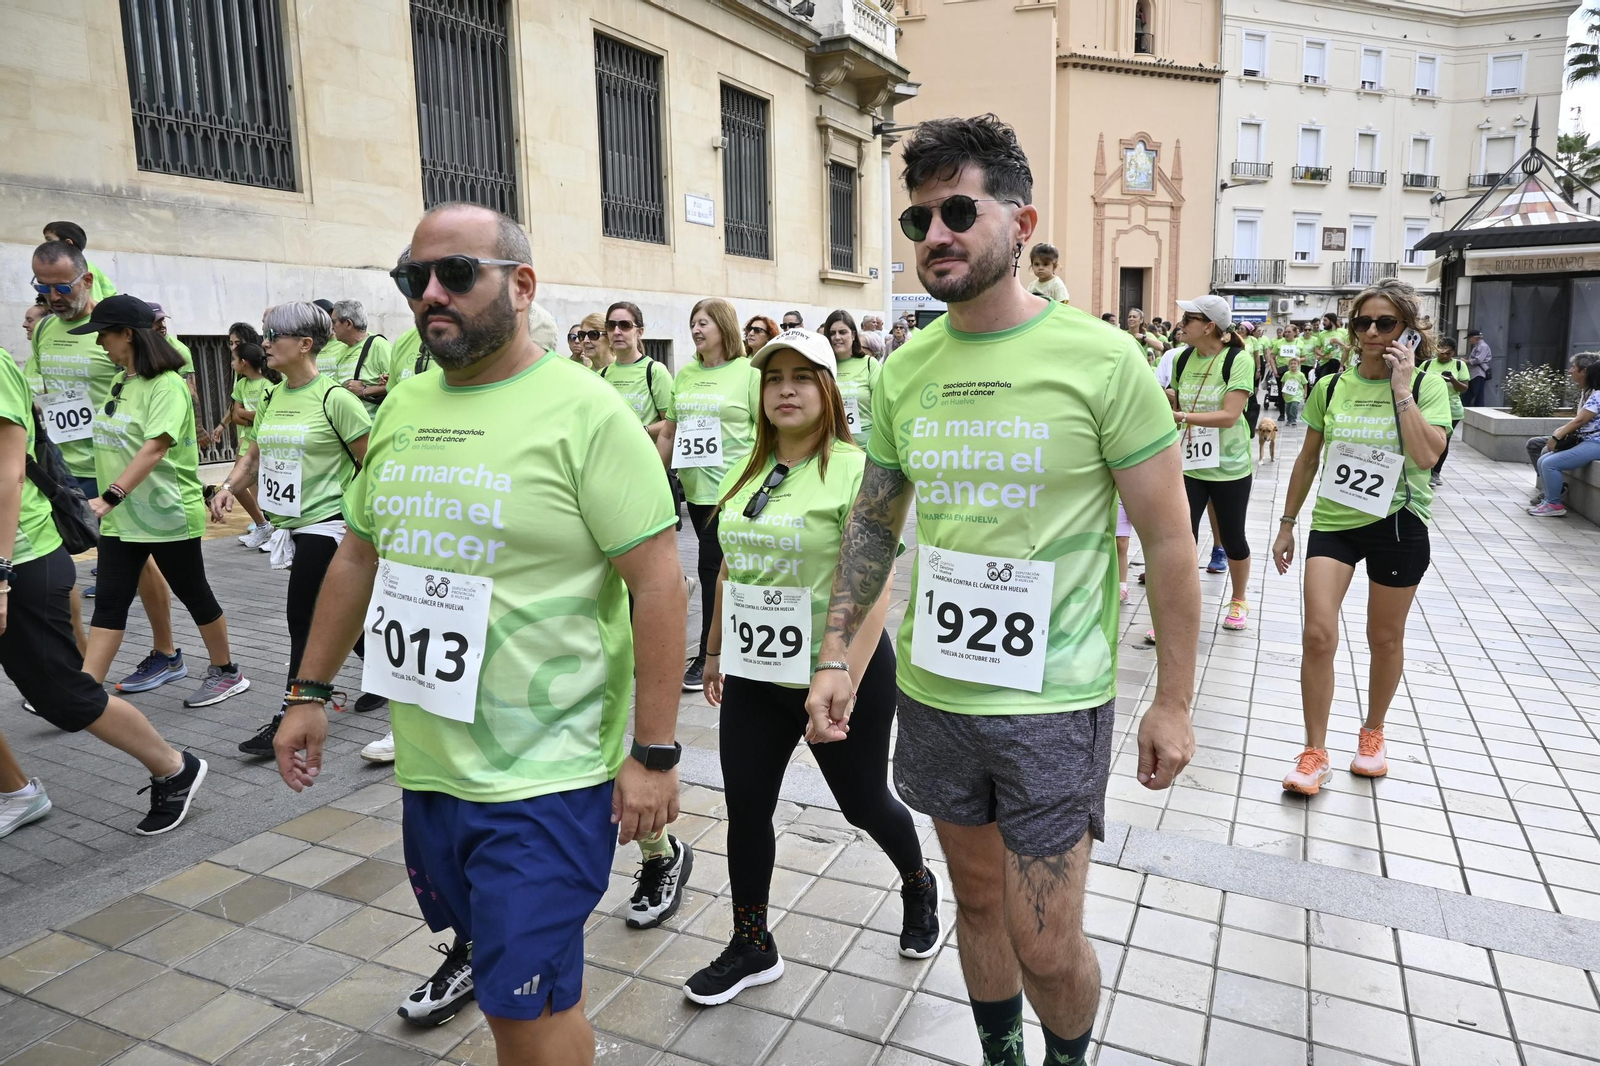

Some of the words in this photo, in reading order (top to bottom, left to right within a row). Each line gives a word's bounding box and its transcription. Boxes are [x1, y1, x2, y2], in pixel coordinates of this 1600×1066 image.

[1495, 258, 1534, 272] BURGUER
[1536, 256, 1584, 270] FERNANDO
[943, 382, 976, 390] asociación
[675, 401, 707, 411] contra
[846, 412, 854, 424] 6
[1336, 413, 1352, 424] En
[1355, 415, 1396, 426] march
[913, 416, 939, 438] En
[945, 415, 1050, 440] marcha
[1333, 426, 1384, 439] contra
[1386, 430, 1398, 440] e
[257, 434, 290, 444] contra
[909, 444, 1004, 471] contra
[1011, 446, 1045, 474] el
[380, 460, 406, 482] En
[411, 463, 512, 493] marcha
[1334, 464, 1384, 498] 922
[915, 472, 1045, 508] cáncer
[374, 490, 463, 521] contra
[468, 498, 505, 530] el
[722, 508, 739, 522] En
[924, 513, 952, 521] MARCHA
[966, 514, 998, 524] HUELVA
[380, 518, 506, 564] cáncer
[719, 528, 776, 549] contra
[779, 532, 802, 552] el
[724, 546, 804, 576] cáncer
[936, 574, 952, 583] MARCHA
[953, 578, 972, 587] CONTRA
[980, 582, 1000, 590] CÁNCER
[397, 593, 412, 602] CONTRA
[418, 596, 436, 608] CÁNCER
[444, 603, 464, 612] HUELVA
[940, 648, 958, 658] HUELVA
[964, 654, 988, 662] OCTUBRE
[988, 656, 1000, 664] 2025
[392, 671, 405, 680] HUELVA
[426, 682, 436, 690] 2025
